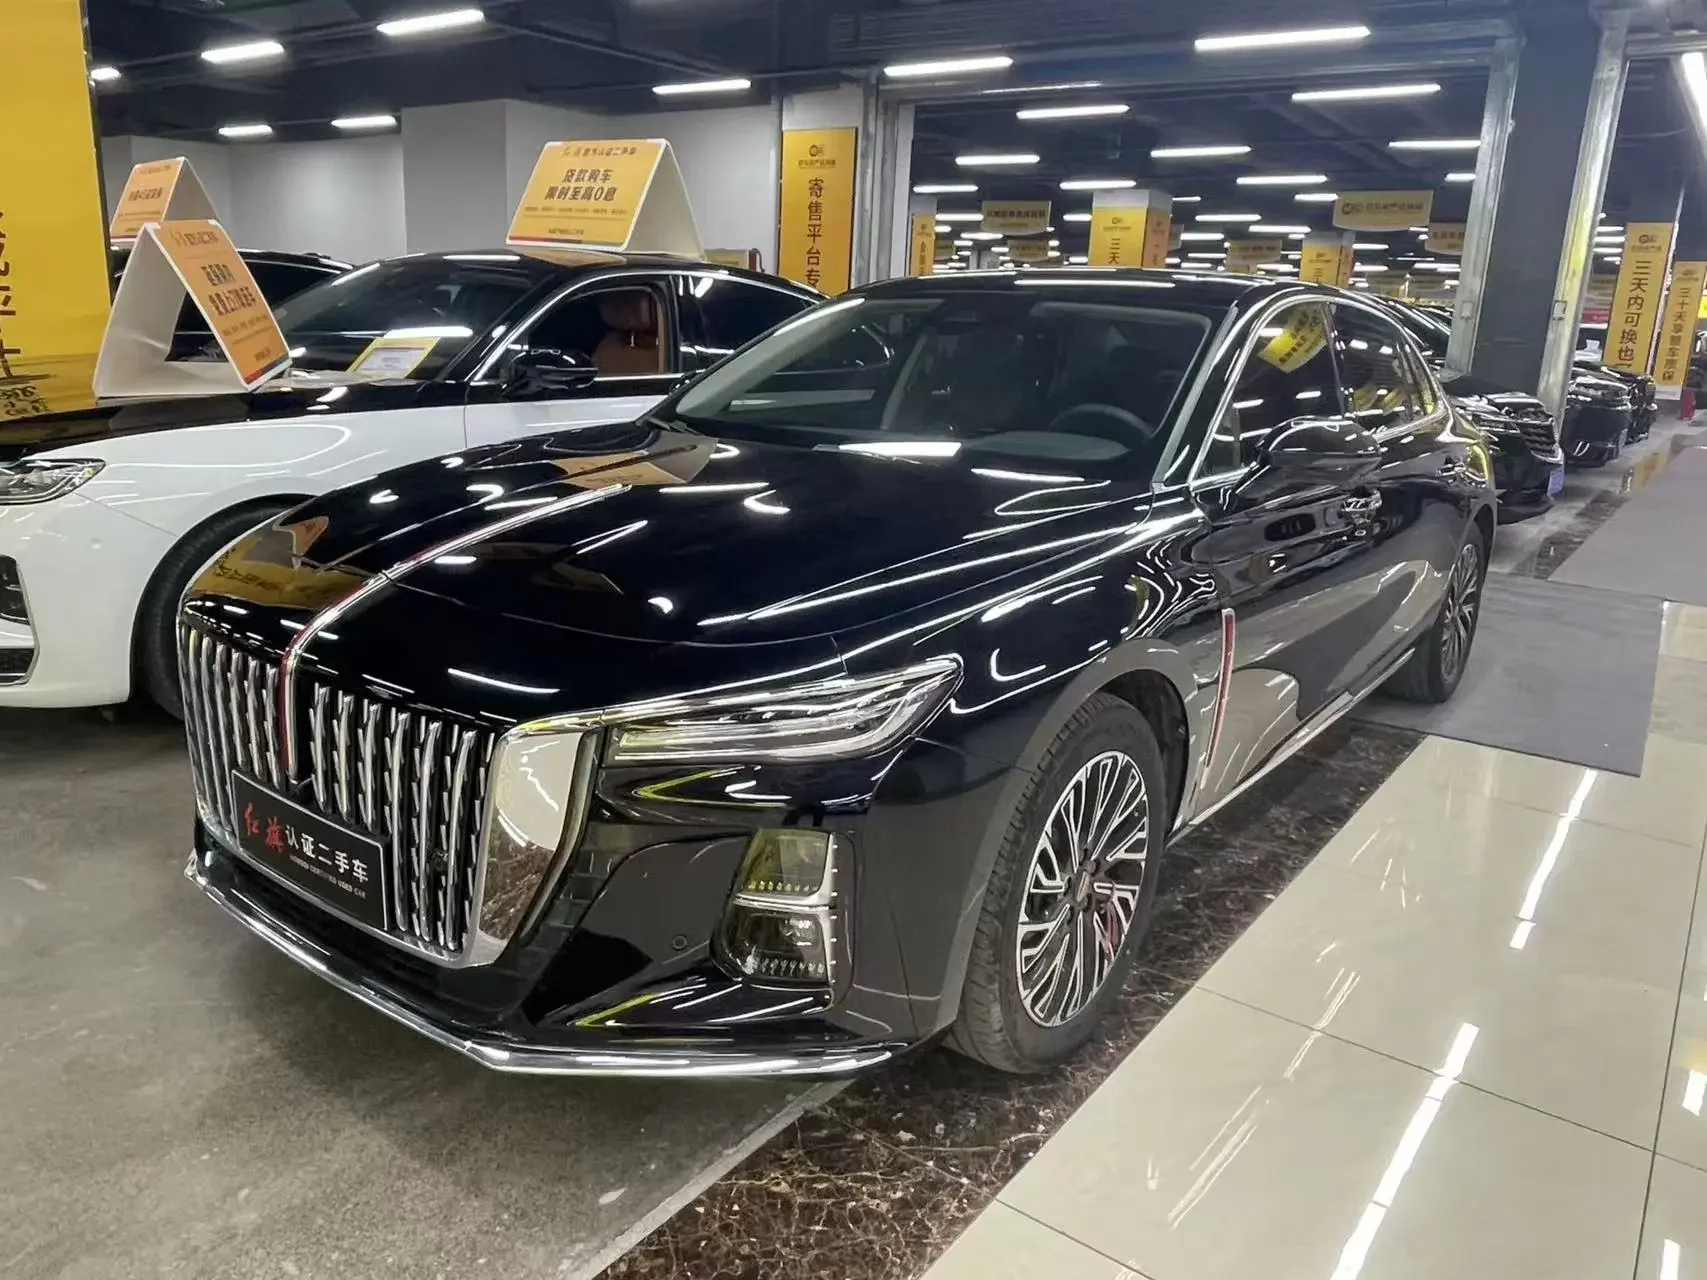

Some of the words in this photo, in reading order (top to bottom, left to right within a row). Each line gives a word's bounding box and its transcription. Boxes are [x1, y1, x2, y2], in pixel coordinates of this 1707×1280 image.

[562, 168, 614, 184] 贷款购车
[544, 185, 618, 202] 限时至高0息
[805, 177, 824, 288] 寄售平台专
[1108, 238, 1121, 264] 三天
[1615, 260, 1652, 369] 三天内可换也
